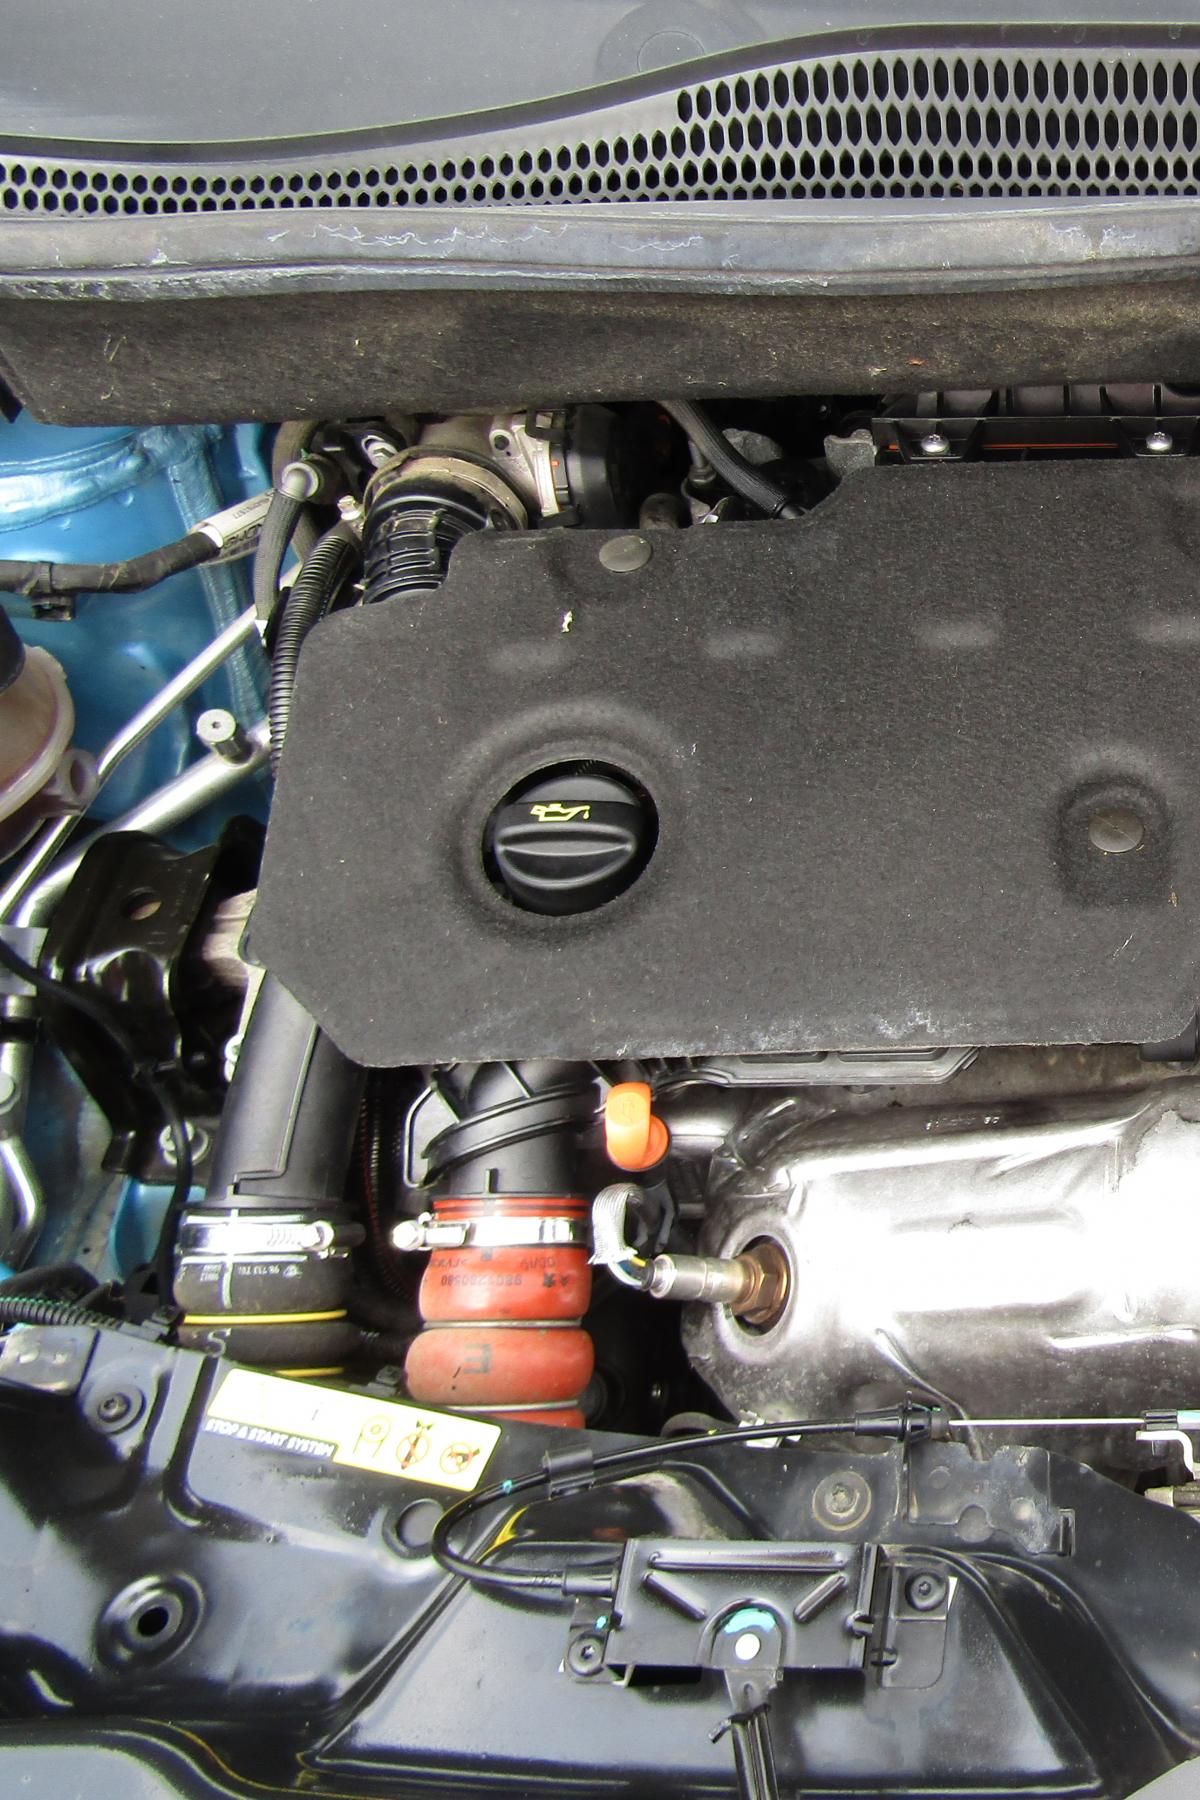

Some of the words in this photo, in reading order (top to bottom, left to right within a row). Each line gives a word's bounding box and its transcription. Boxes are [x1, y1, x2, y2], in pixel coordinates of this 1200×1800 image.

[204, 1418, 239, 1436] STOP
[248, 1427, 289, 1446] START
[286, 1436, 334, 1457] SYSTEM
